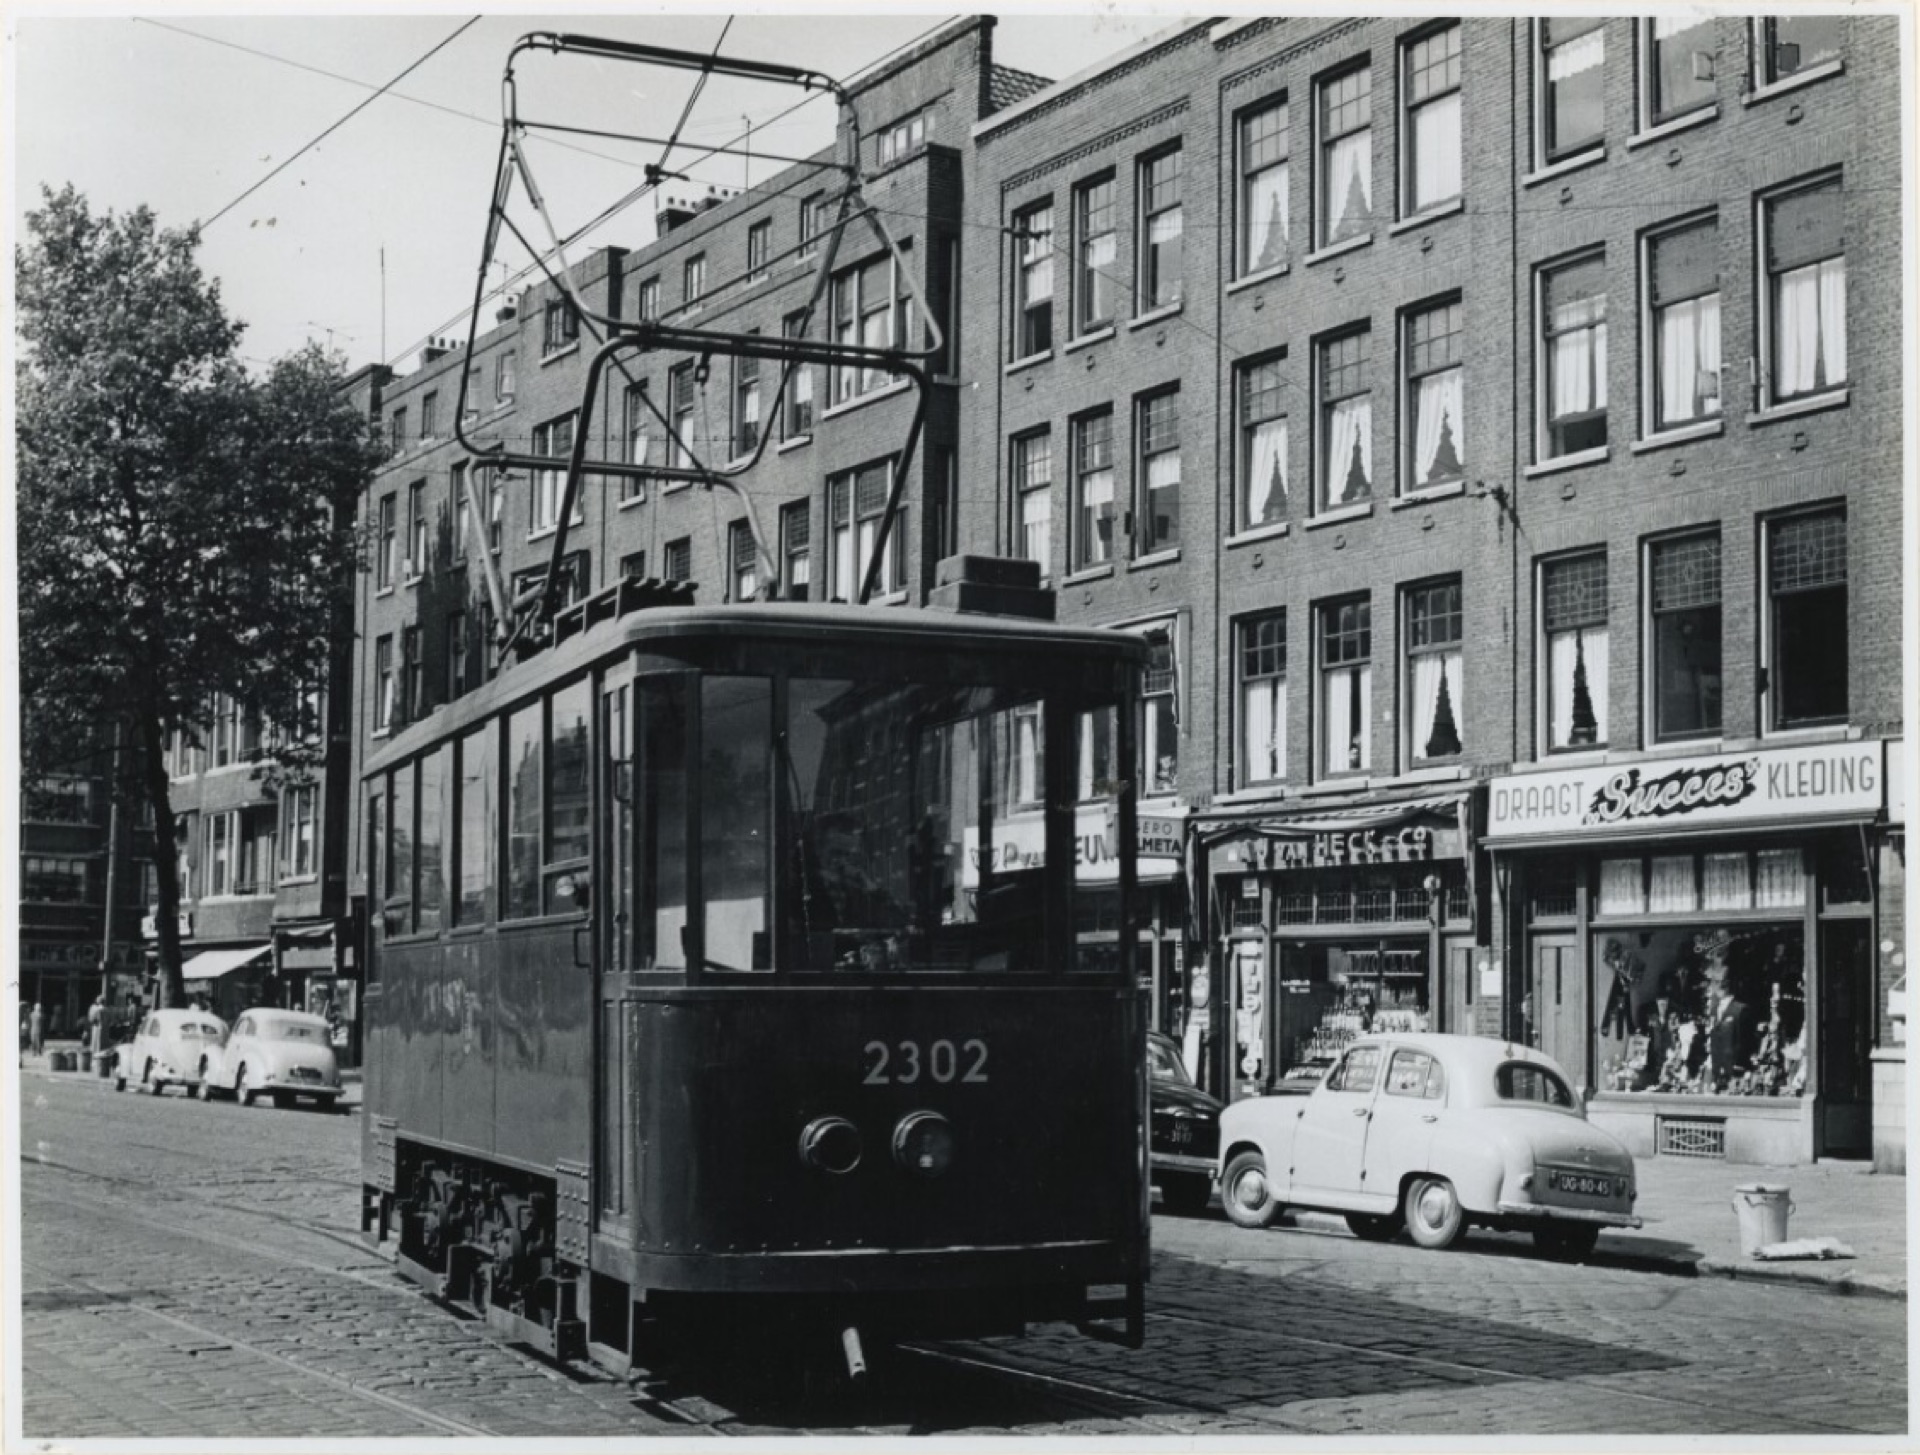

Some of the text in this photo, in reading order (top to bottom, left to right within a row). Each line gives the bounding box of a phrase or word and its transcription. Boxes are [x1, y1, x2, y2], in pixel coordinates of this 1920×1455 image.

[1495, 781, 1585, 822] DRAAGT
[1767, 756, 1875, 800] KLEDING
[1137, 820, 1173, 836] ERO
[1314, 829, 1376, 857] HECK
[862, 1039, 988, 1084] 2302
